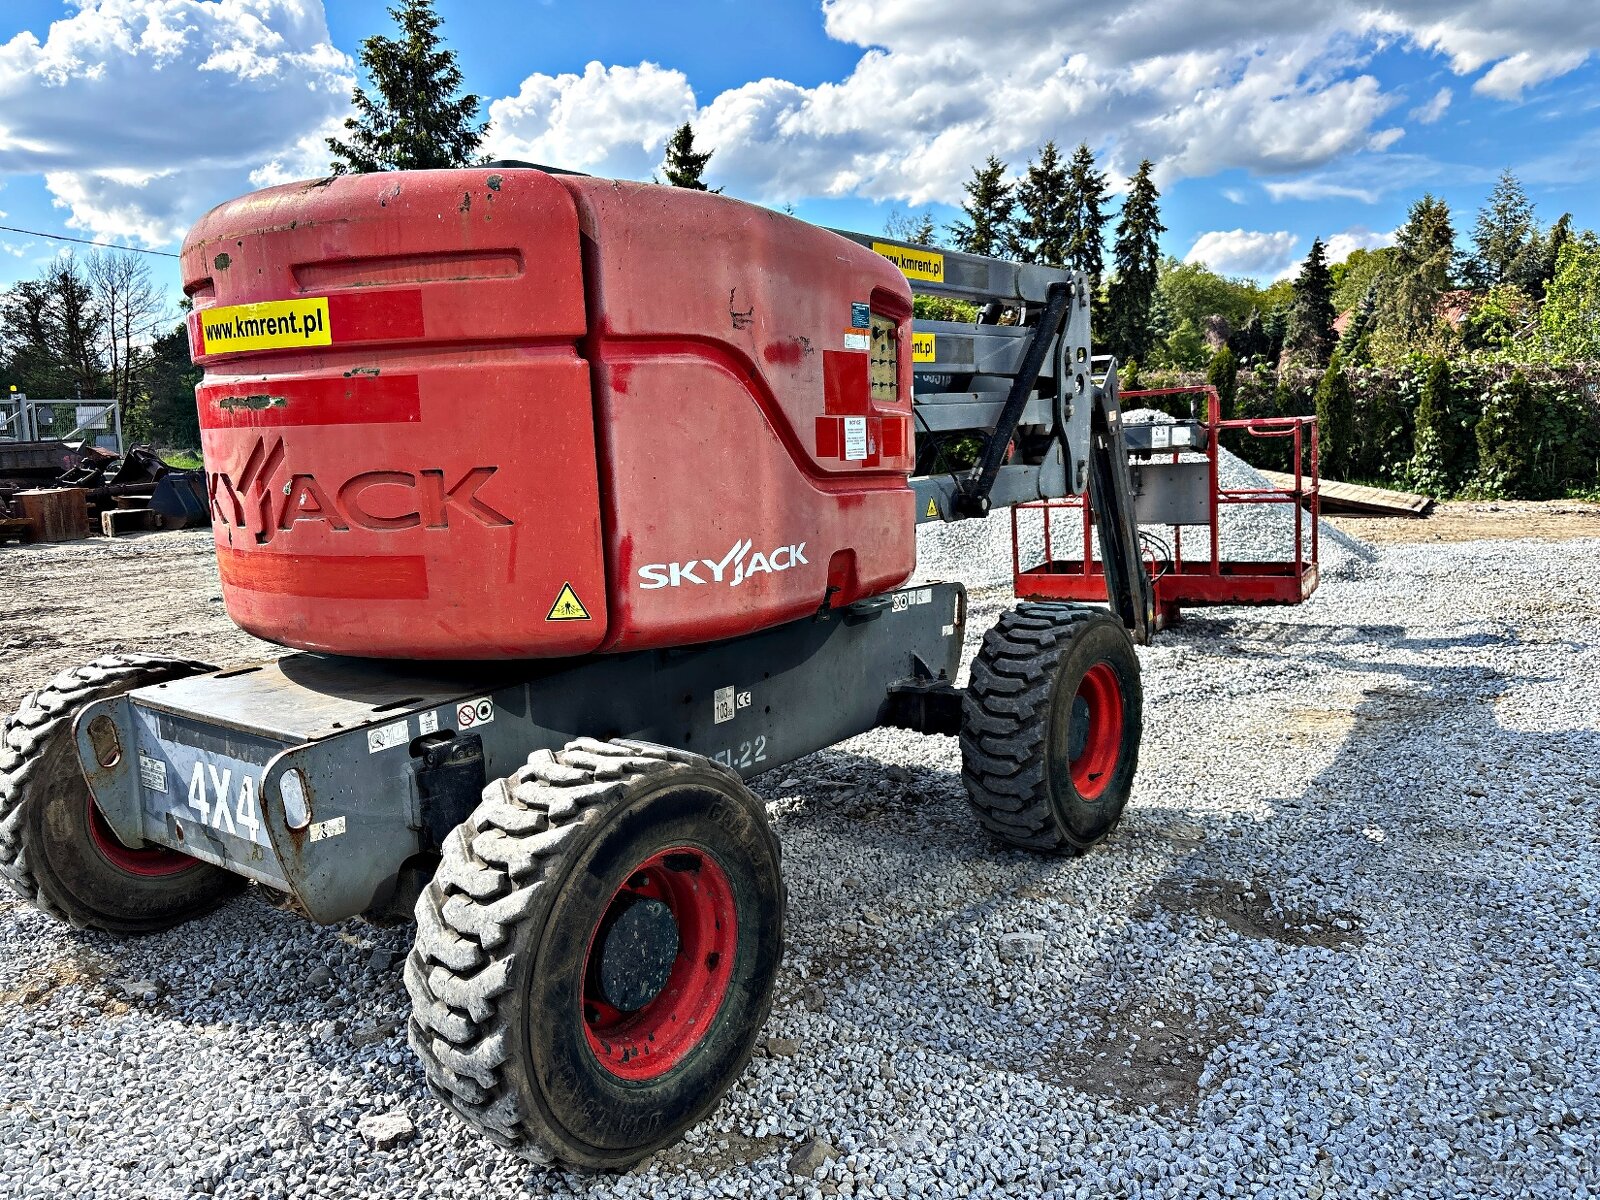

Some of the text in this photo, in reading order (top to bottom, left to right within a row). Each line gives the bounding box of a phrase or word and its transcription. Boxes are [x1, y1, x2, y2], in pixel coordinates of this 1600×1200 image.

[205, 308, 323, 339] www.kmrent.pl
[206, 435, 515, 545] KYJACK
[638, 538, 809, 589] SKYJACK
[188, 761, 260, 841] 4X4
